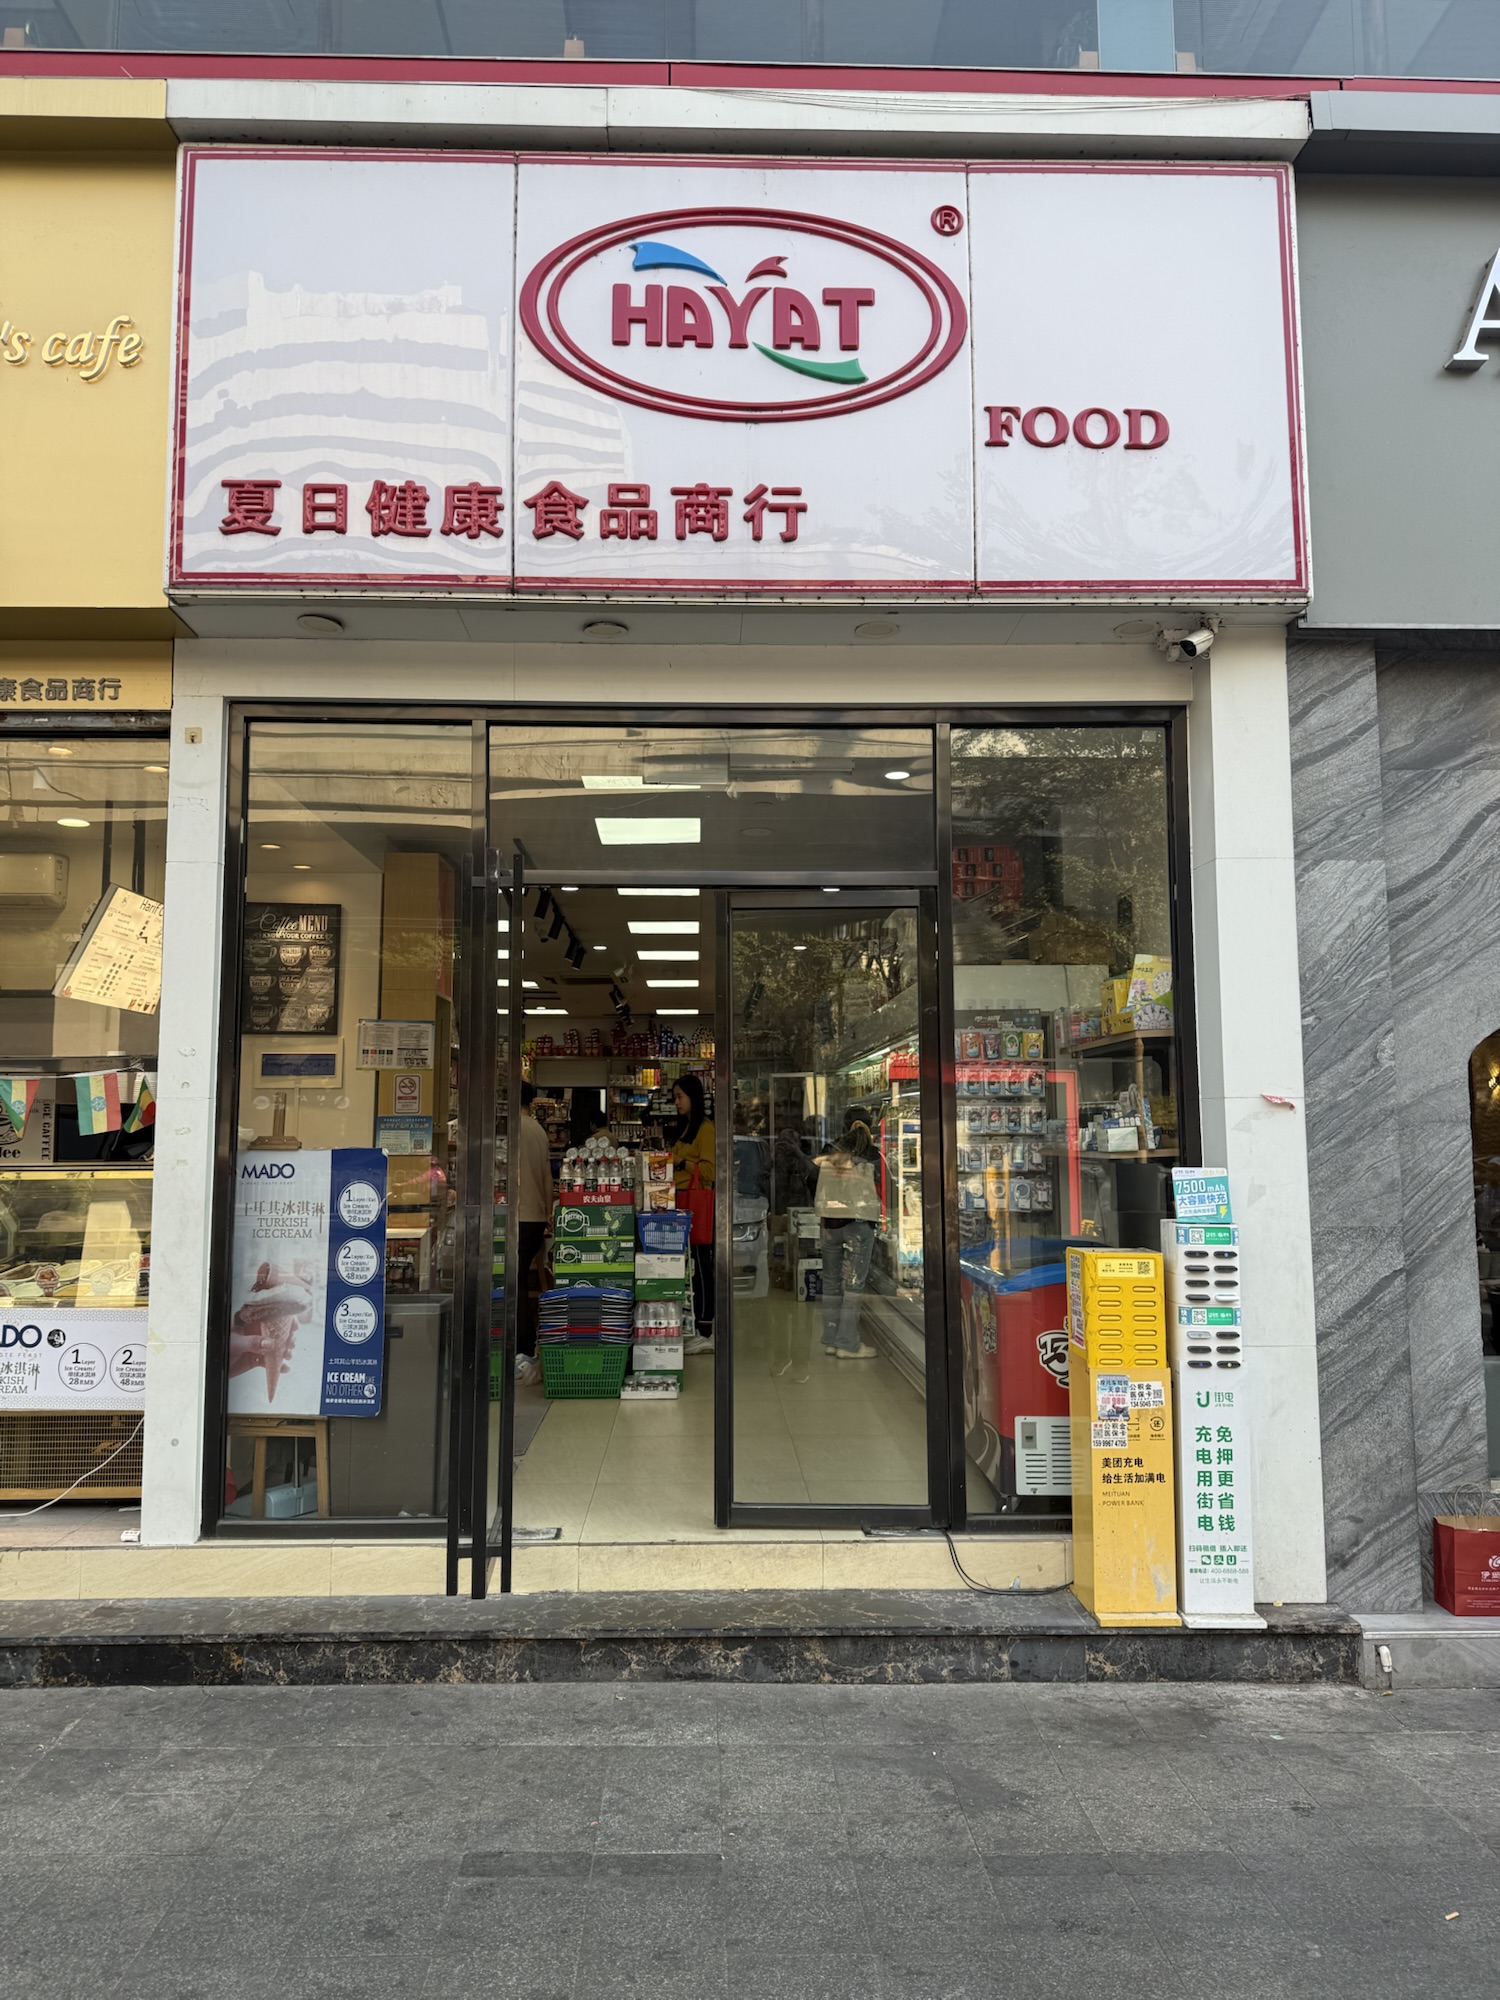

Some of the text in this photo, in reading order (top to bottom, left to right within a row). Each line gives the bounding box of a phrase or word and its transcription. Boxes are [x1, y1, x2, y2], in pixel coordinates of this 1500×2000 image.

[612, 282, 876, 351] HAYAT
[41, 315, 144, 383] cafe
[983, 405, 1170, 450] FOOD
[218, 479, 809, 542] 夏日健康食品商行
[298, 915, 328, 932] MENU
[241, 1163, 296, 1179] MADO
[1175, 1179, 1226, 1194] 7500 mAh
[345, 1189, 353, 1202] 1
[582, 1194, 612, 1204] 农夫山泉
[1178, 1193, 1227, 1207] 大容量快充
[257, 1217, 308, 1227] TURKISH
[343, 1245, 351, 1259] 2
[340, 1303, 349, 1317] 3
[71, 1348, 81, 1364] 1
[121, 1349, 133, 1365] 2
[327, 1371, 340, 1383] ICE
[340, 1372, 366, 1384] CREAM
[325, 1384, 363, 1397] NO OTHER
[1129, 1383, 1152, 1391] 公积金
[1214, 1391, 1234, 1403] 街电
[1103, 1422, 1127, 1430] 公积金
[1104, 1429, 1127, 1437] 医保卡
[1101, 1456, 1144, 1469] 美团充电
[1101, 1472, 1166, 1484] 给生活加满电
[1194, 1425, 1214, 1532] 充电用街电
[1216, 1425, 1236, 1532] 免押更省钱
